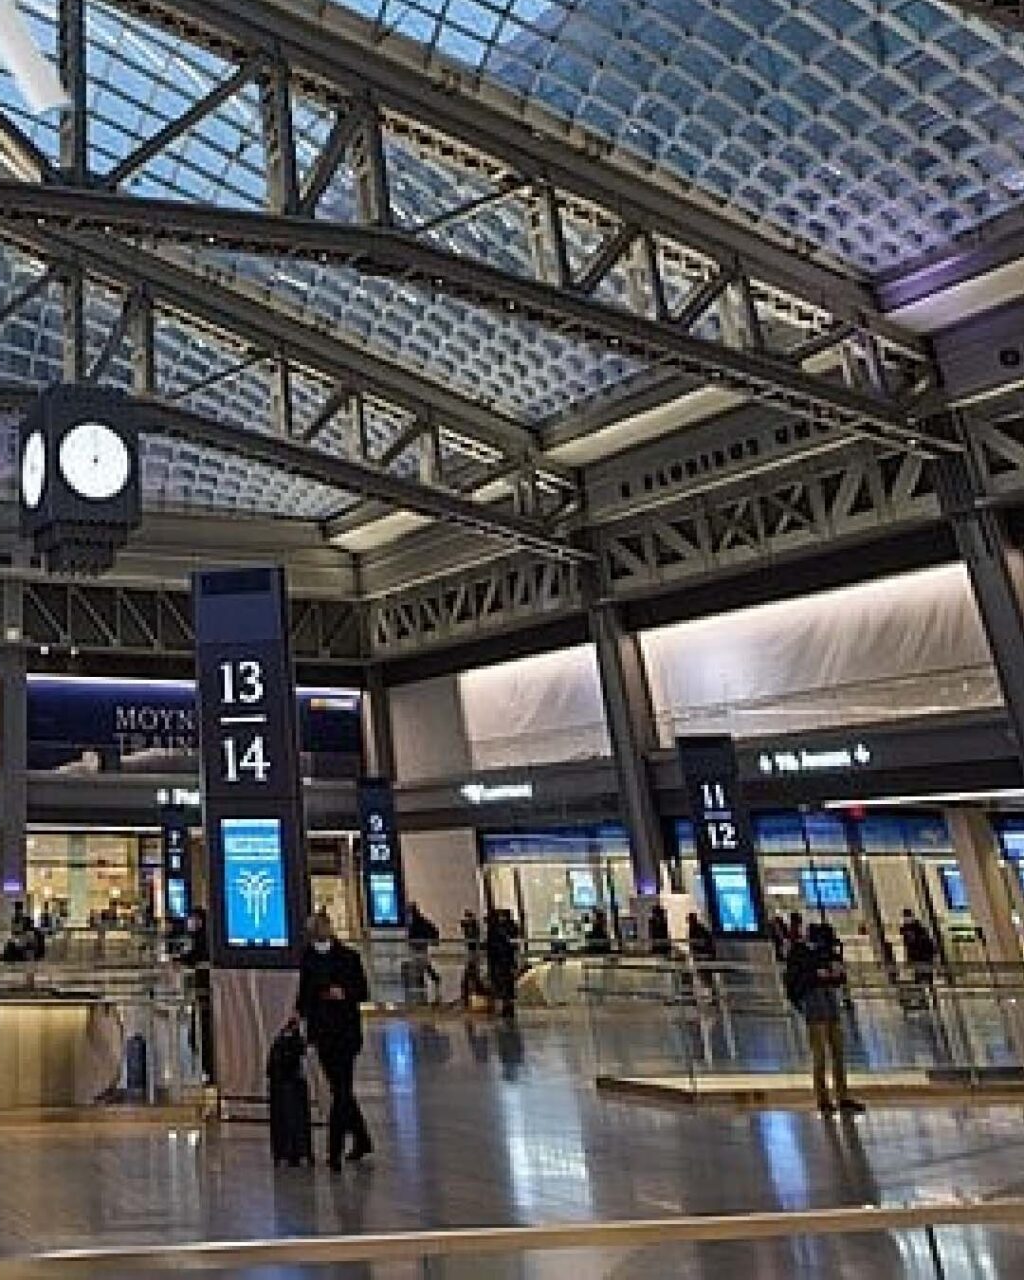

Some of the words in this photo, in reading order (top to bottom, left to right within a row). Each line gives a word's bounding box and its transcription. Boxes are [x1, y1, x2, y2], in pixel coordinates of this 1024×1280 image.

[220, 661, 263, 703] 13
[223, 735, 271, 782] 14
[701, 783, 725, 809] 11
[708, 822, 737, 850] 12
